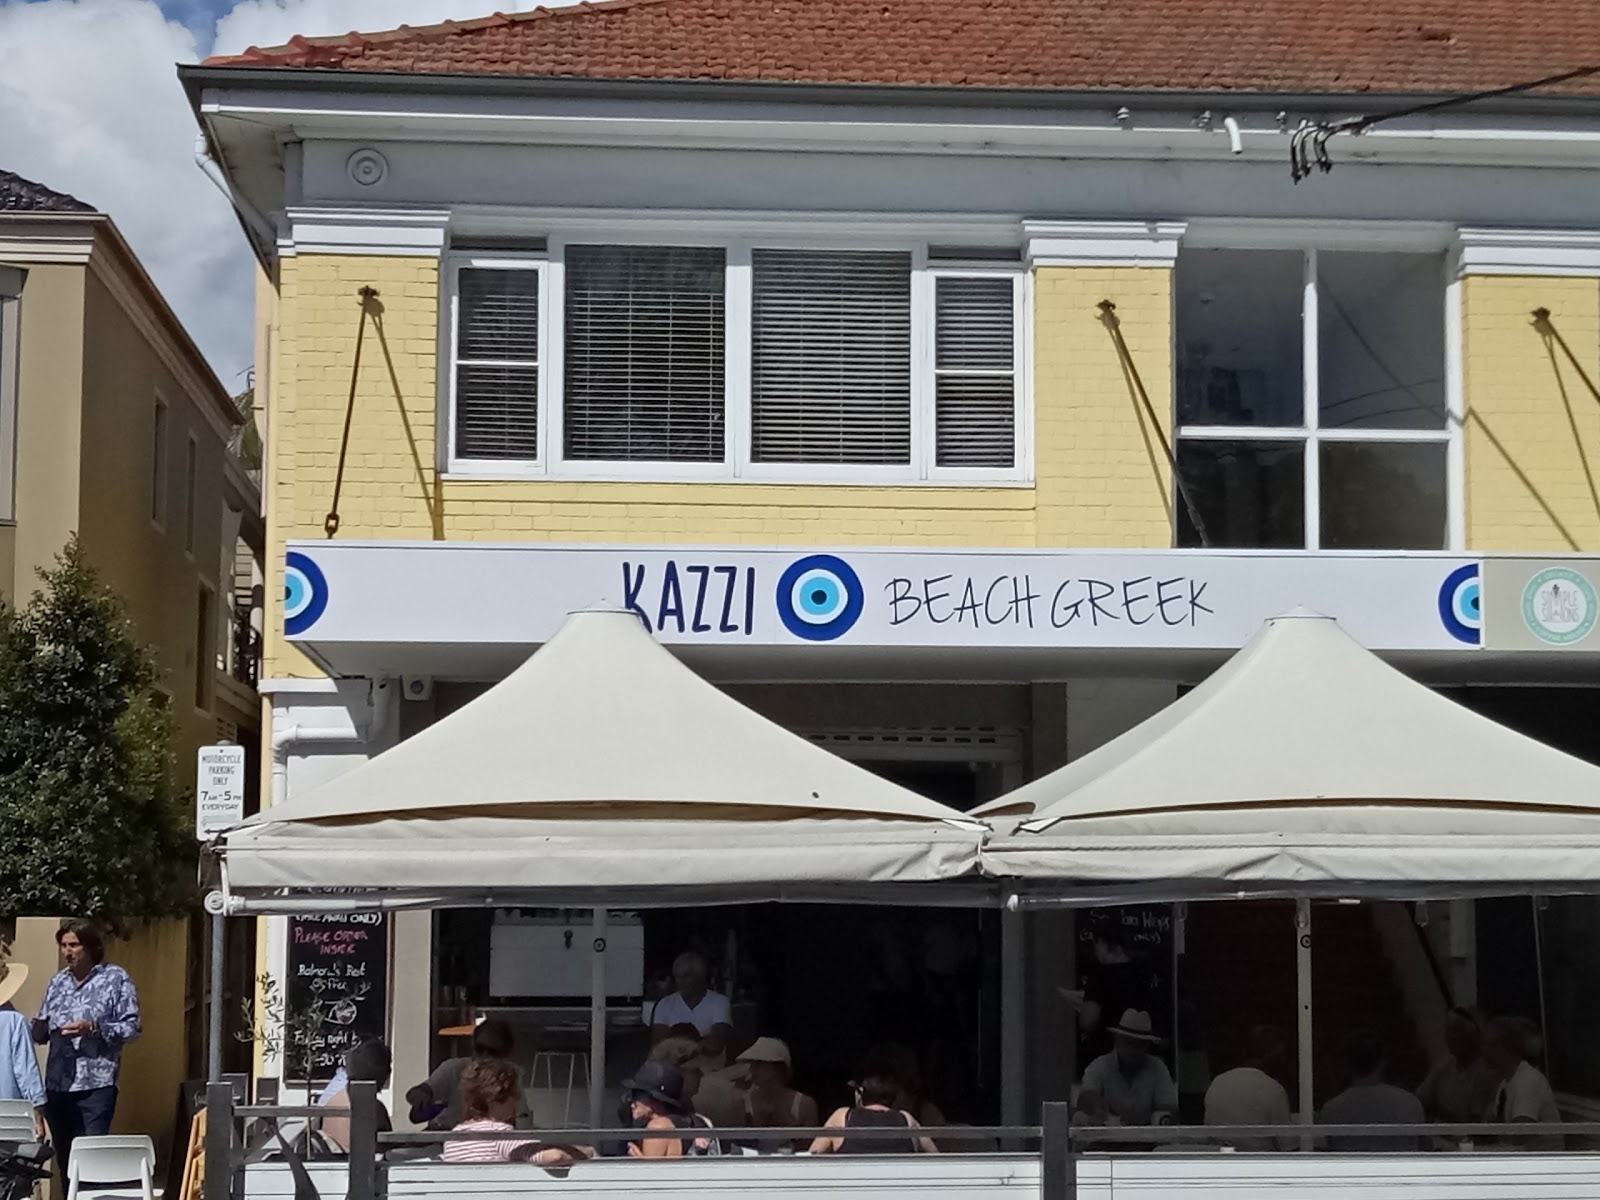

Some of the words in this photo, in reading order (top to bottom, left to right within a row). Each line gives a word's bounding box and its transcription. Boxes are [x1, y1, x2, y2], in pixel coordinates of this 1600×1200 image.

[623, 561, 756, 635] KAZZI
[884, 575, 1041, 628] BEACH
[1051, 576, 1214, 628] GREEK
[202, 754, 241, 764] MOTORCYCLE
[209, 766, 236, 775] PARKING
[213, 776, 229, 786] ONLY
